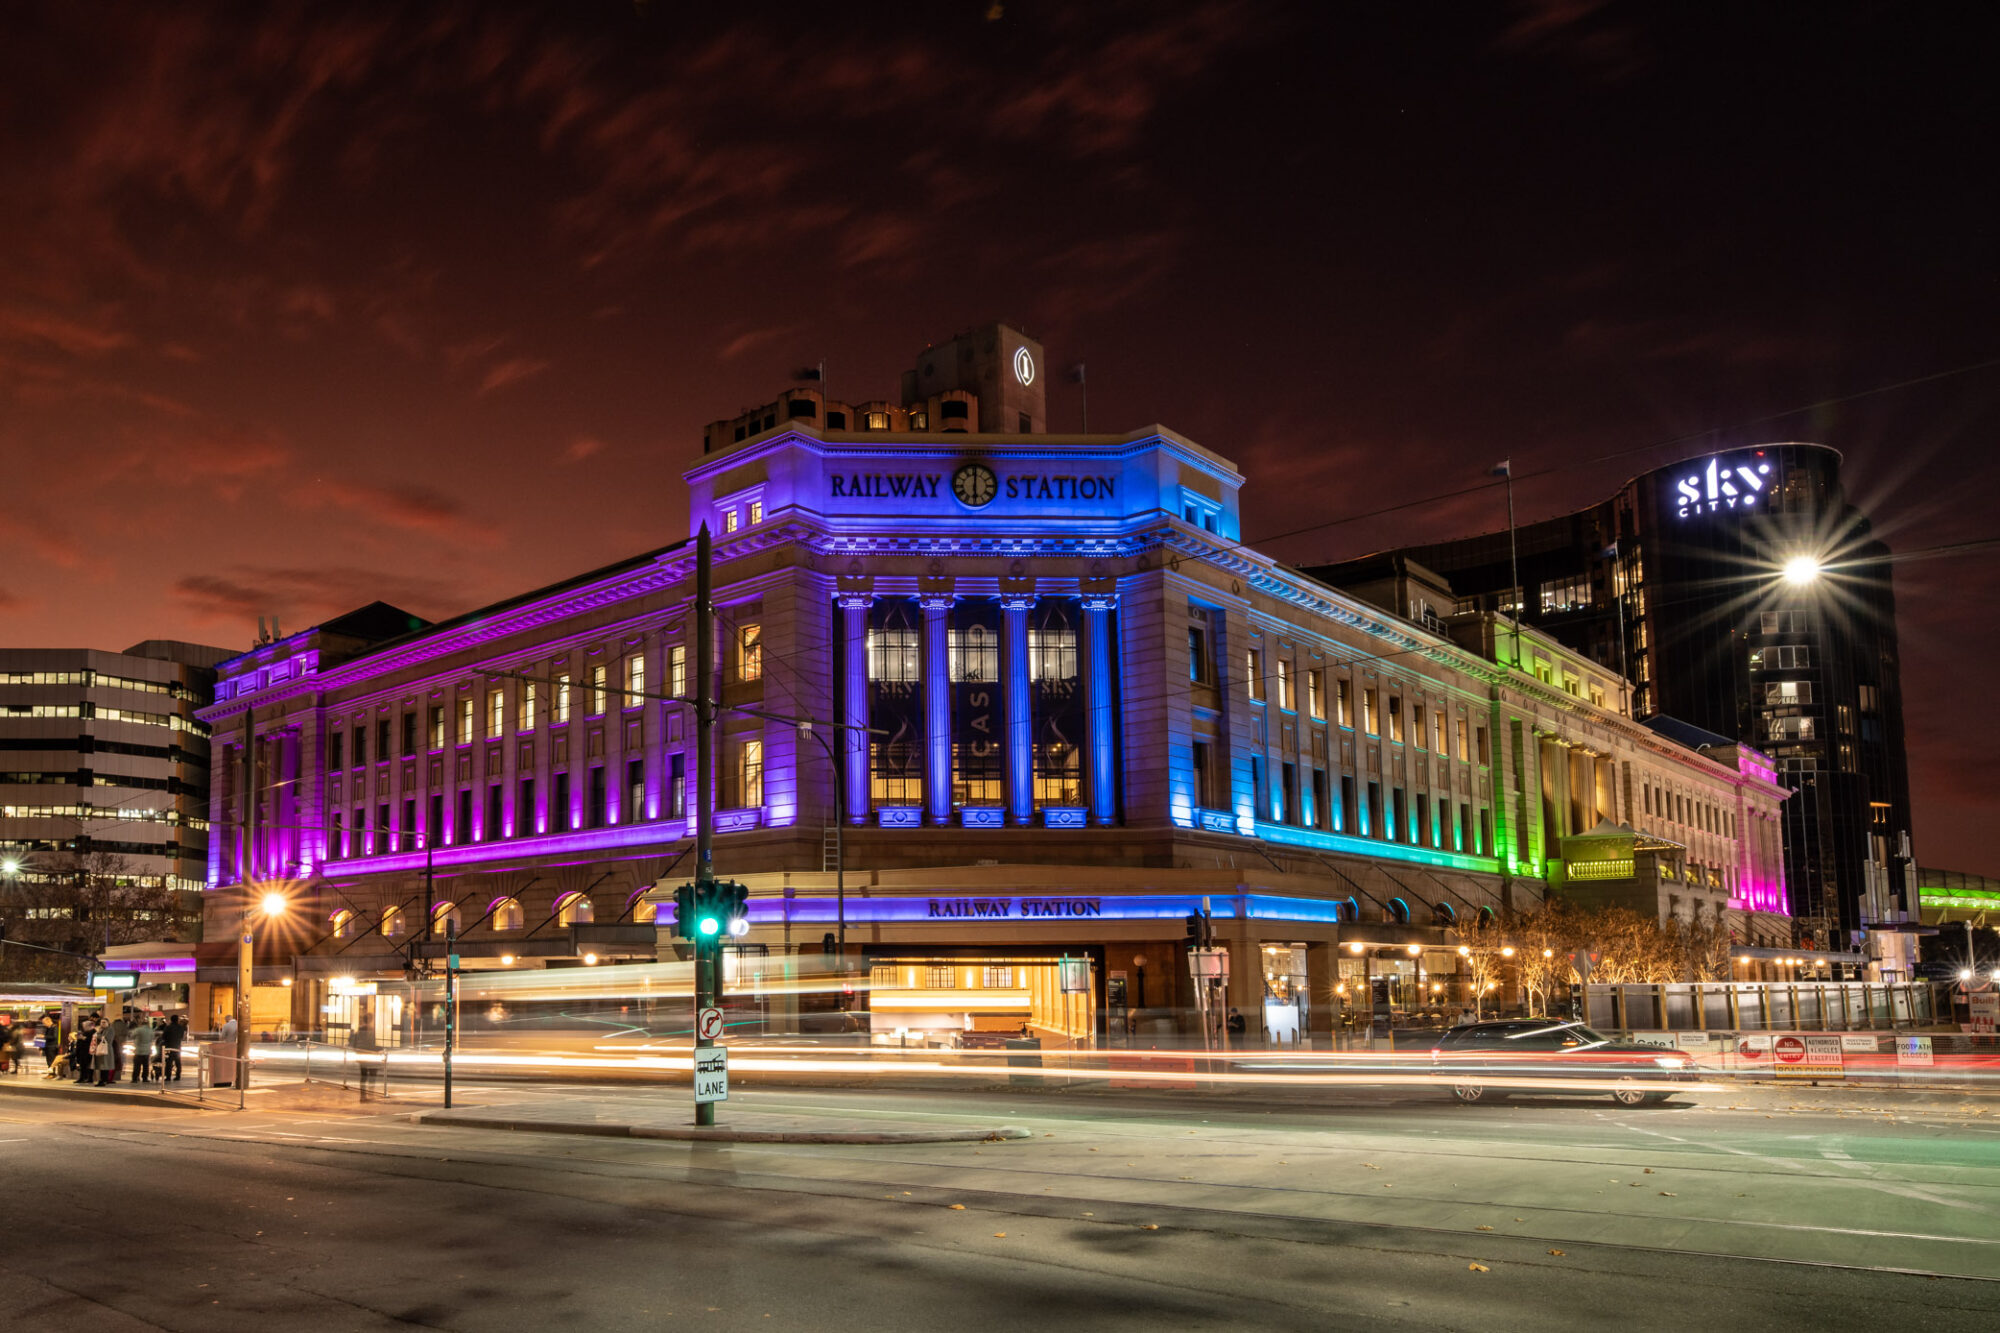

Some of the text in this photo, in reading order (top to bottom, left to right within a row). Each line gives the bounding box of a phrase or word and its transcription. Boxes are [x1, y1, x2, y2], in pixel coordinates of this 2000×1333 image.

[831, 474, 1115, 499] RAILWAY STATION
[1679, 498, 1736, 517] CITY
[929, 902, 1100, 916] RAILWAY STATION
[698, 1081, 725, 1095] LANE
